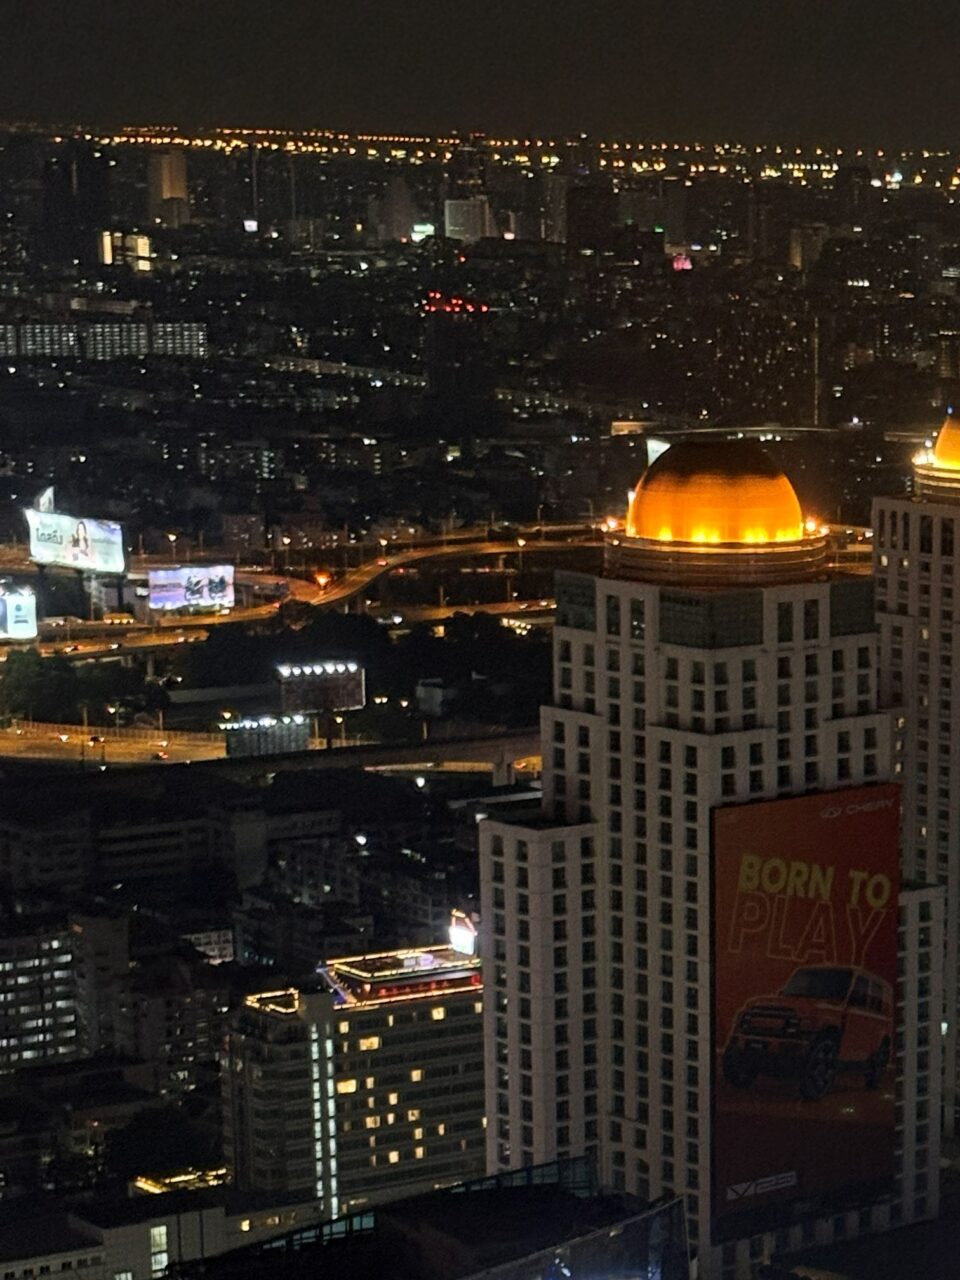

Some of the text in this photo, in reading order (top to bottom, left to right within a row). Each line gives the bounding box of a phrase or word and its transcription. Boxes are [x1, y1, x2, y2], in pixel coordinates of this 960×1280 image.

[739, 853, 892, 908] BORN TO
[727, 891, 888, 968] PLAY
